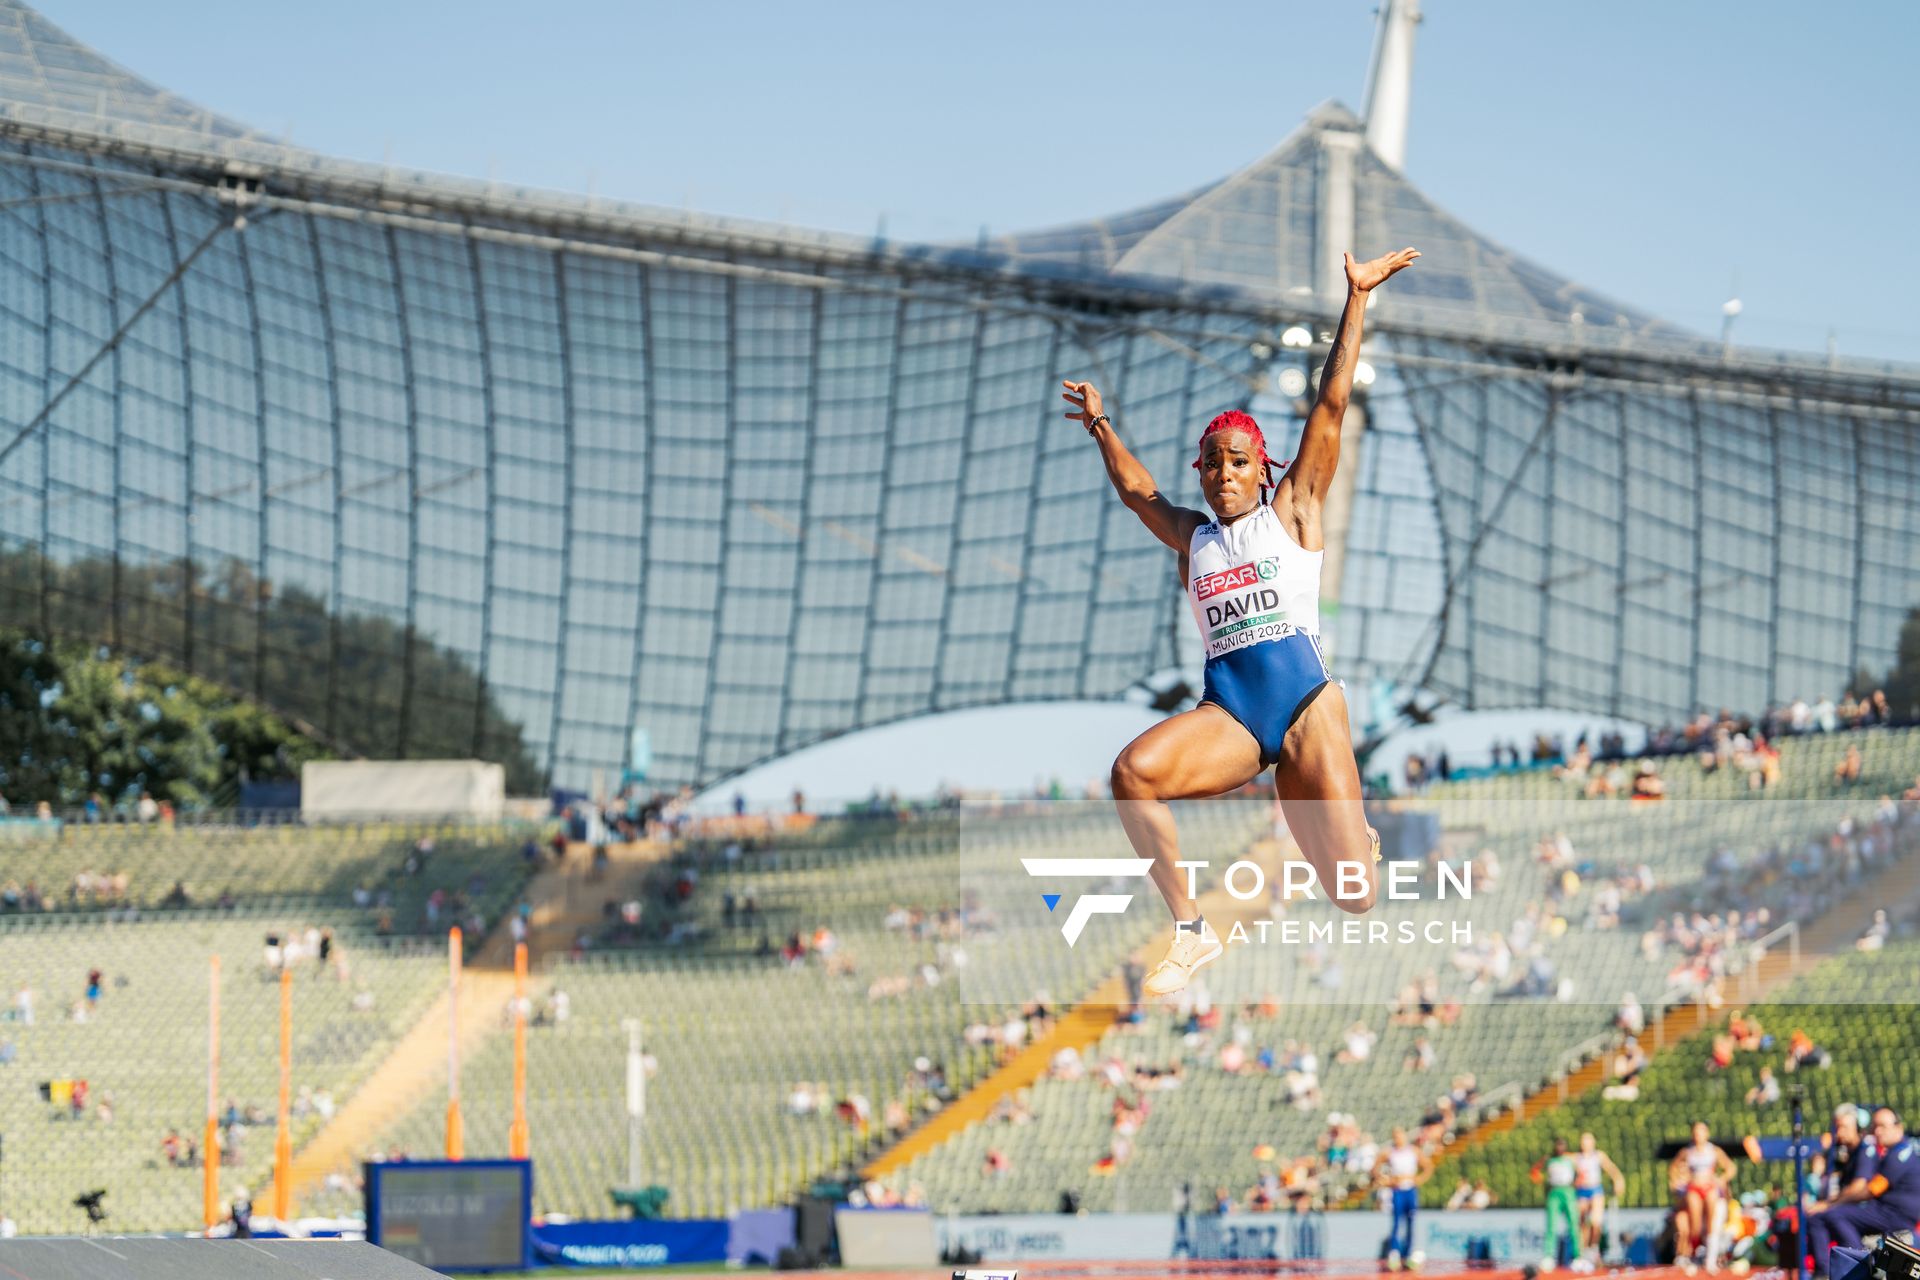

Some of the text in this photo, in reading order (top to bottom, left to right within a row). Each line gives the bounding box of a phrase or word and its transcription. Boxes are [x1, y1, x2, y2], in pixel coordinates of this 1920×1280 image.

[1198, 566, 1256, 598] SPAR
[1206, 589, 1279, 628] DAVID
[1212, 622, 1290, 654] MUNICH 2022
[1225, 624, 1241, 634] RUN
